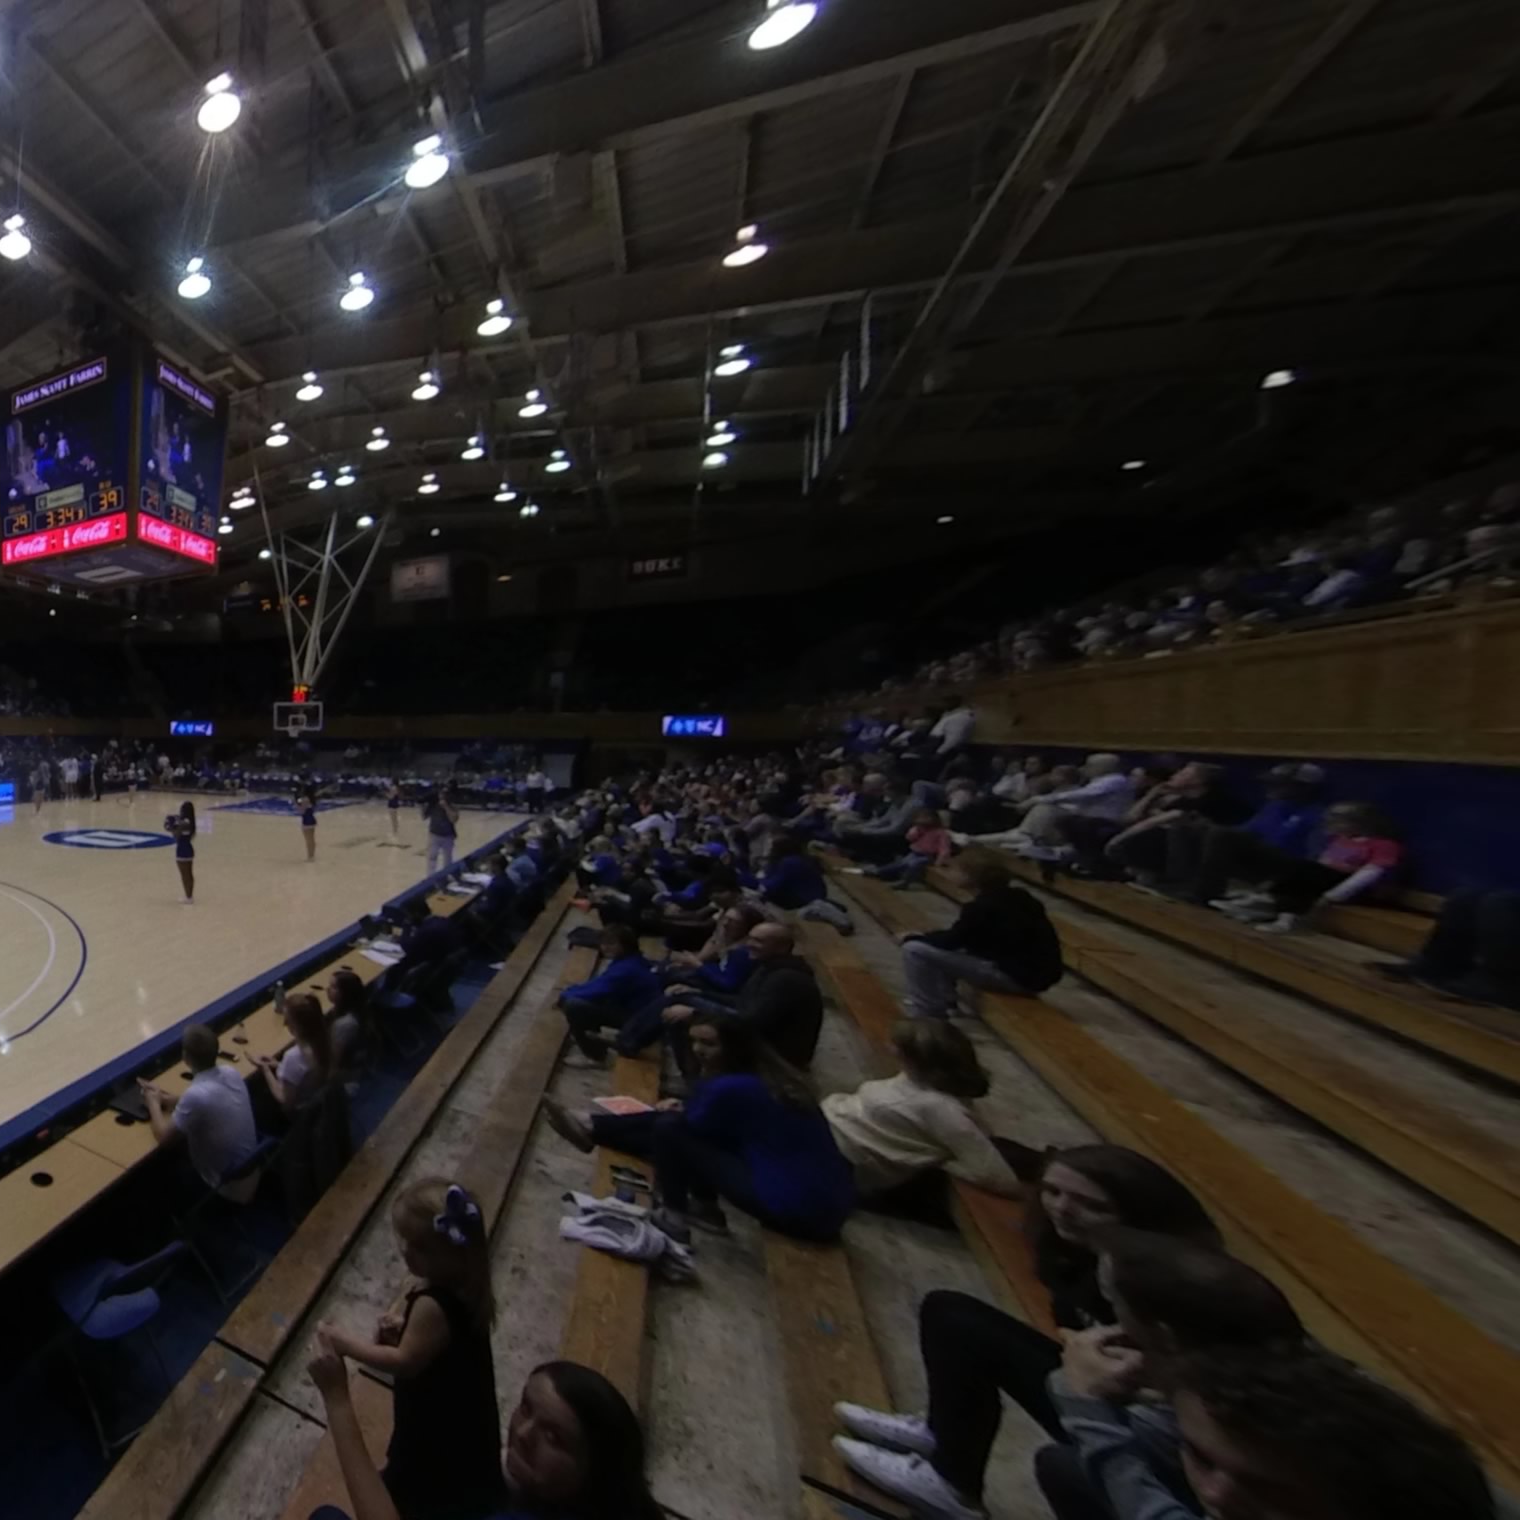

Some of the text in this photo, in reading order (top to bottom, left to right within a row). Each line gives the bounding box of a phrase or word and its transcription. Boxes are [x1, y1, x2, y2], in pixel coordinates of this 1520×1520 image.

[99, 489, 117, 511] 39
[12, 513, 28, 533] 29
[72, 520, 110, 544] Coca-Cola
